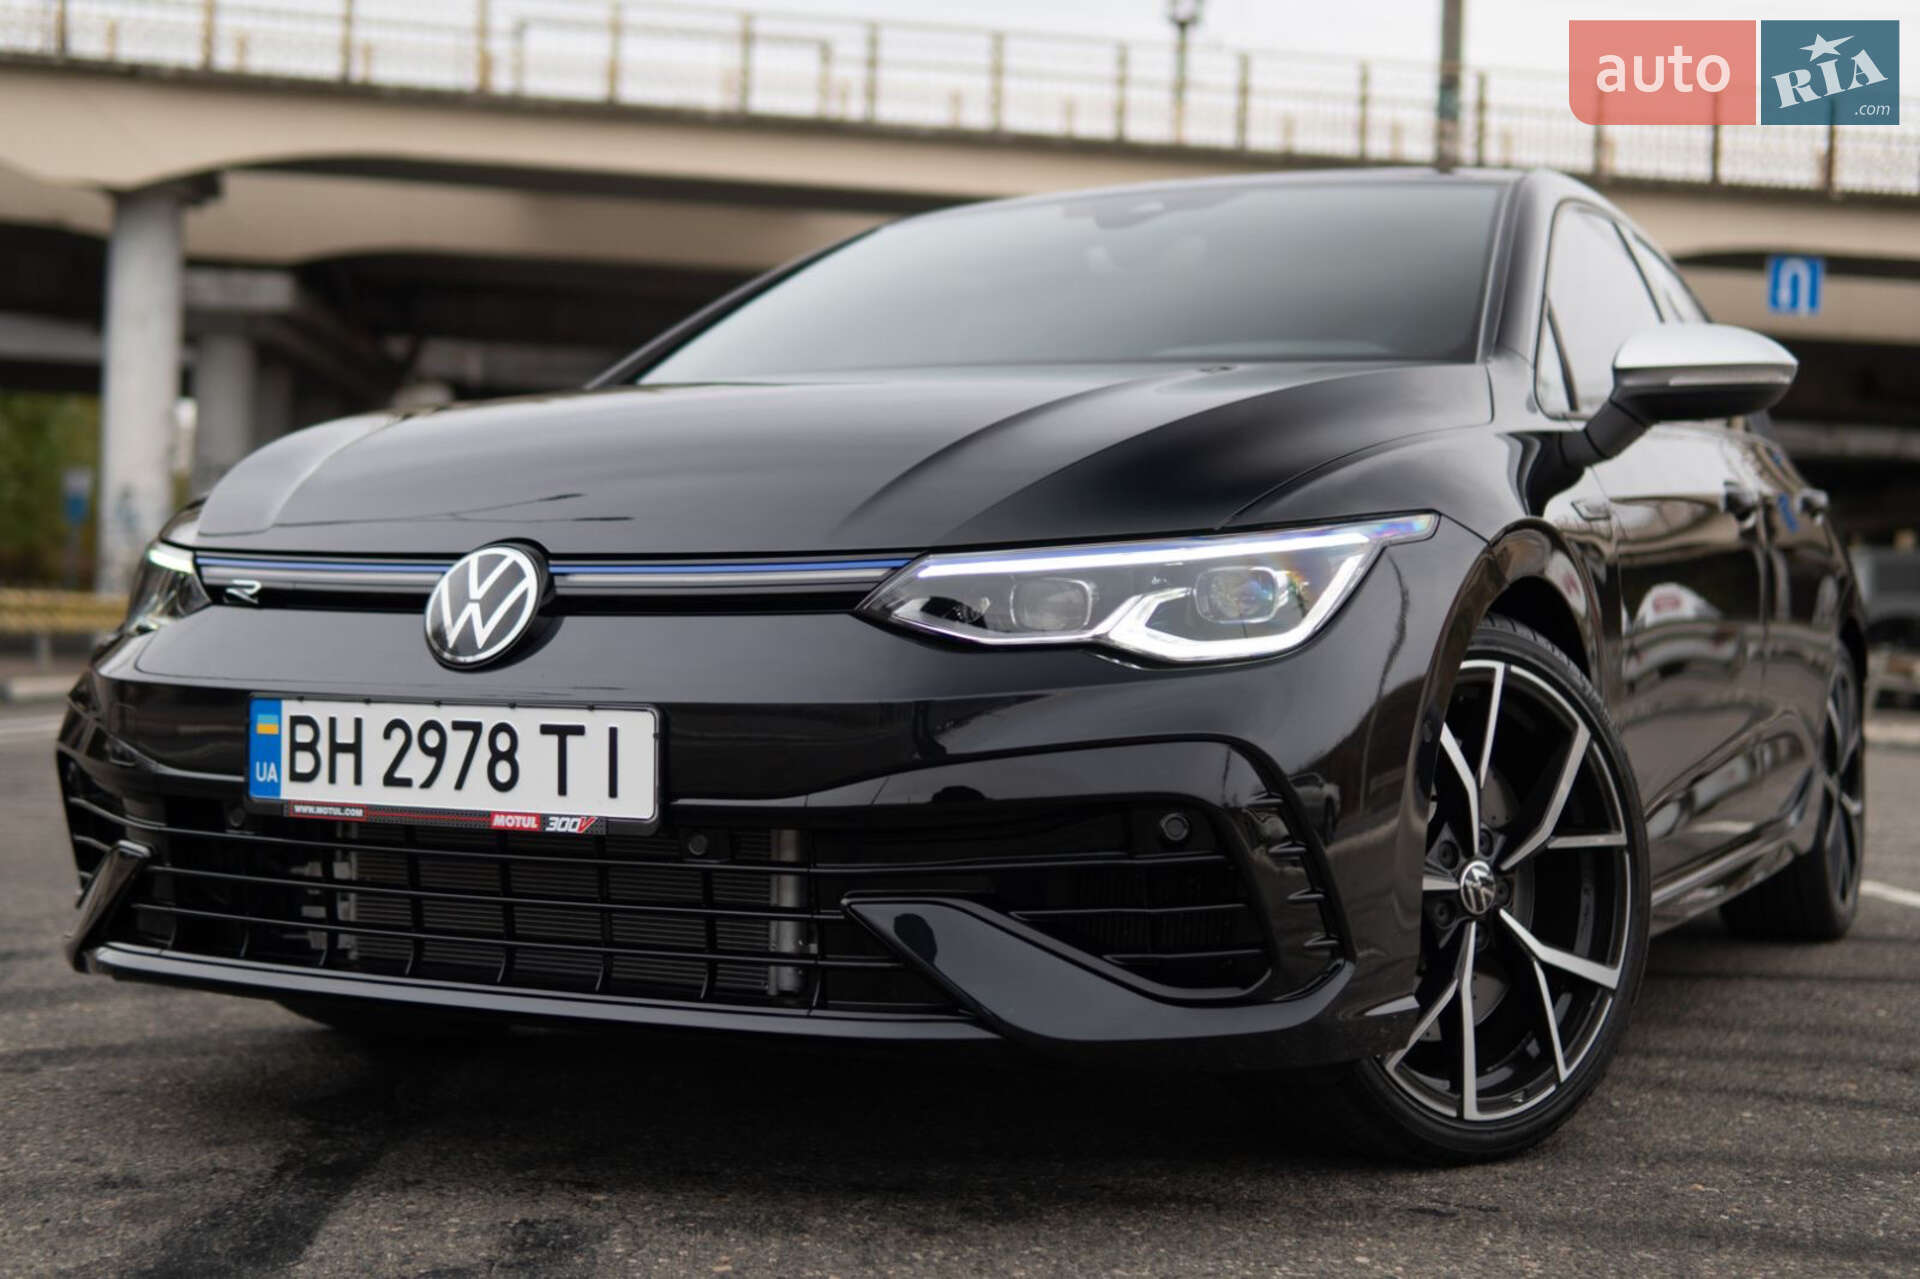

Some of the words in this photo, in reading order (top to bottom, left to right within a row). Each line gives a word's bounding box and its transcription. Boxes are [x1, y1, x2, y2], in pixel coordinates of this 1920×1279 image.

[288, 715, 363, 786] BH
[382, 718, 520, 793] 2978
[256, 761, 278, 784] UA
[493, 814, 538, 828] MOTUL
[545, 816, 598, 833] 300V
